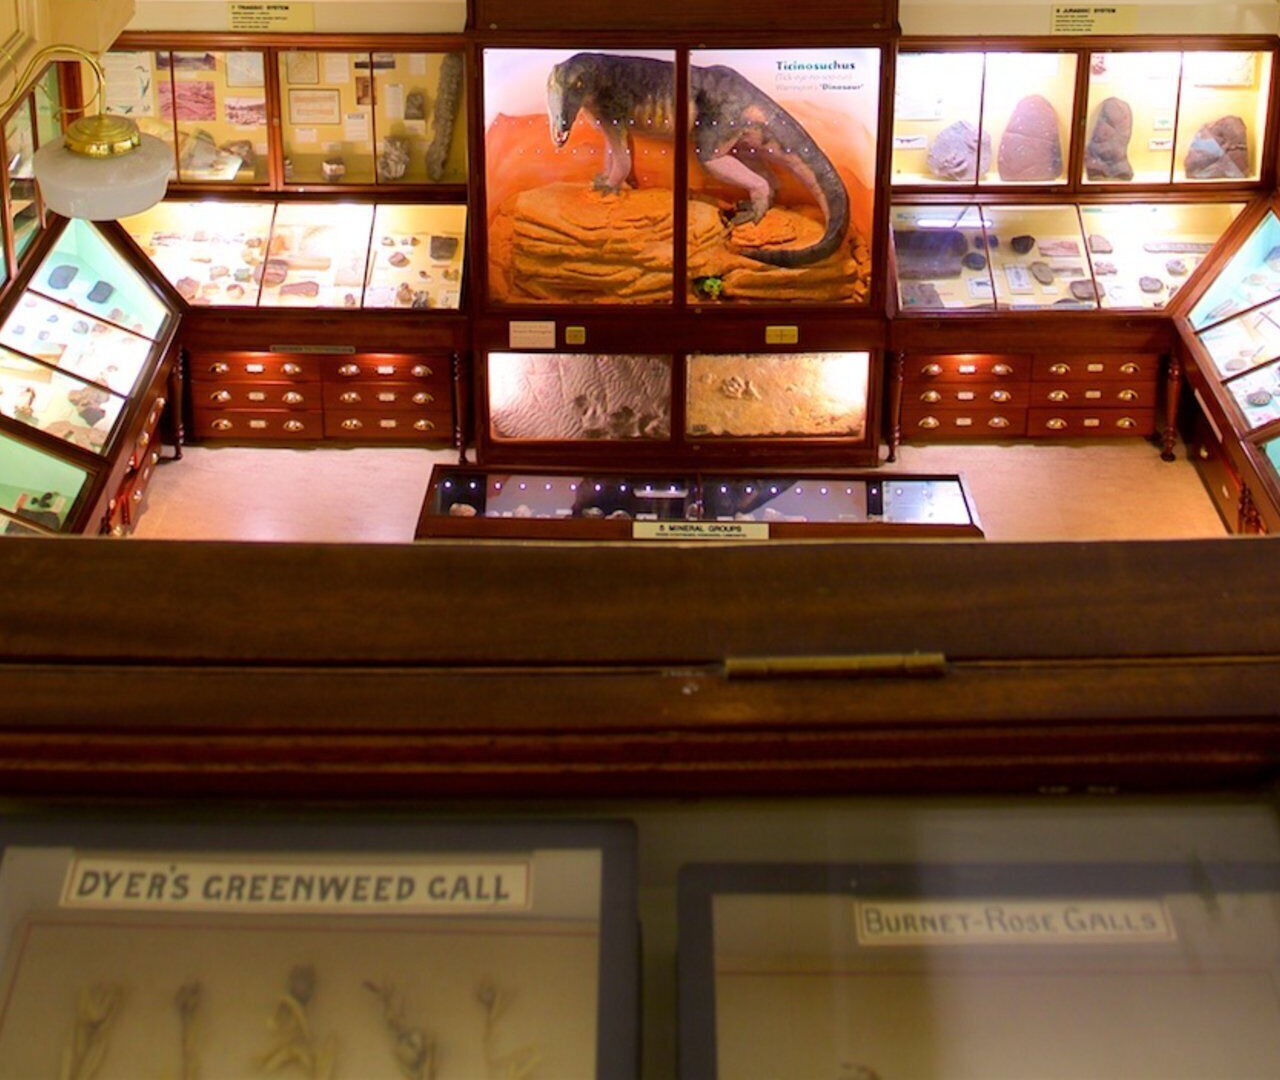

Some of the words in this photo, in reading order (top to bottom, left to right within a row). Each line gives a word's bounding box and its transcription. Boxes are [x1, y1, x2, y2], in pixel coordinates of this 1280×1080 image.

[776, 60, 856, 71] Ticinosuchus
[669, 524, 703, 532] MINERAL
[708, 524, 742, 533] GROUPS
[77, 865, 190, 900] DYER'S
[201, 872, 416, 903] GREENWEED
[427, 874, 511, 903] GALL
[864, 905, 1060, 934] BURNET-ROSE
[1063, 906, 1157, 933] GALLS
